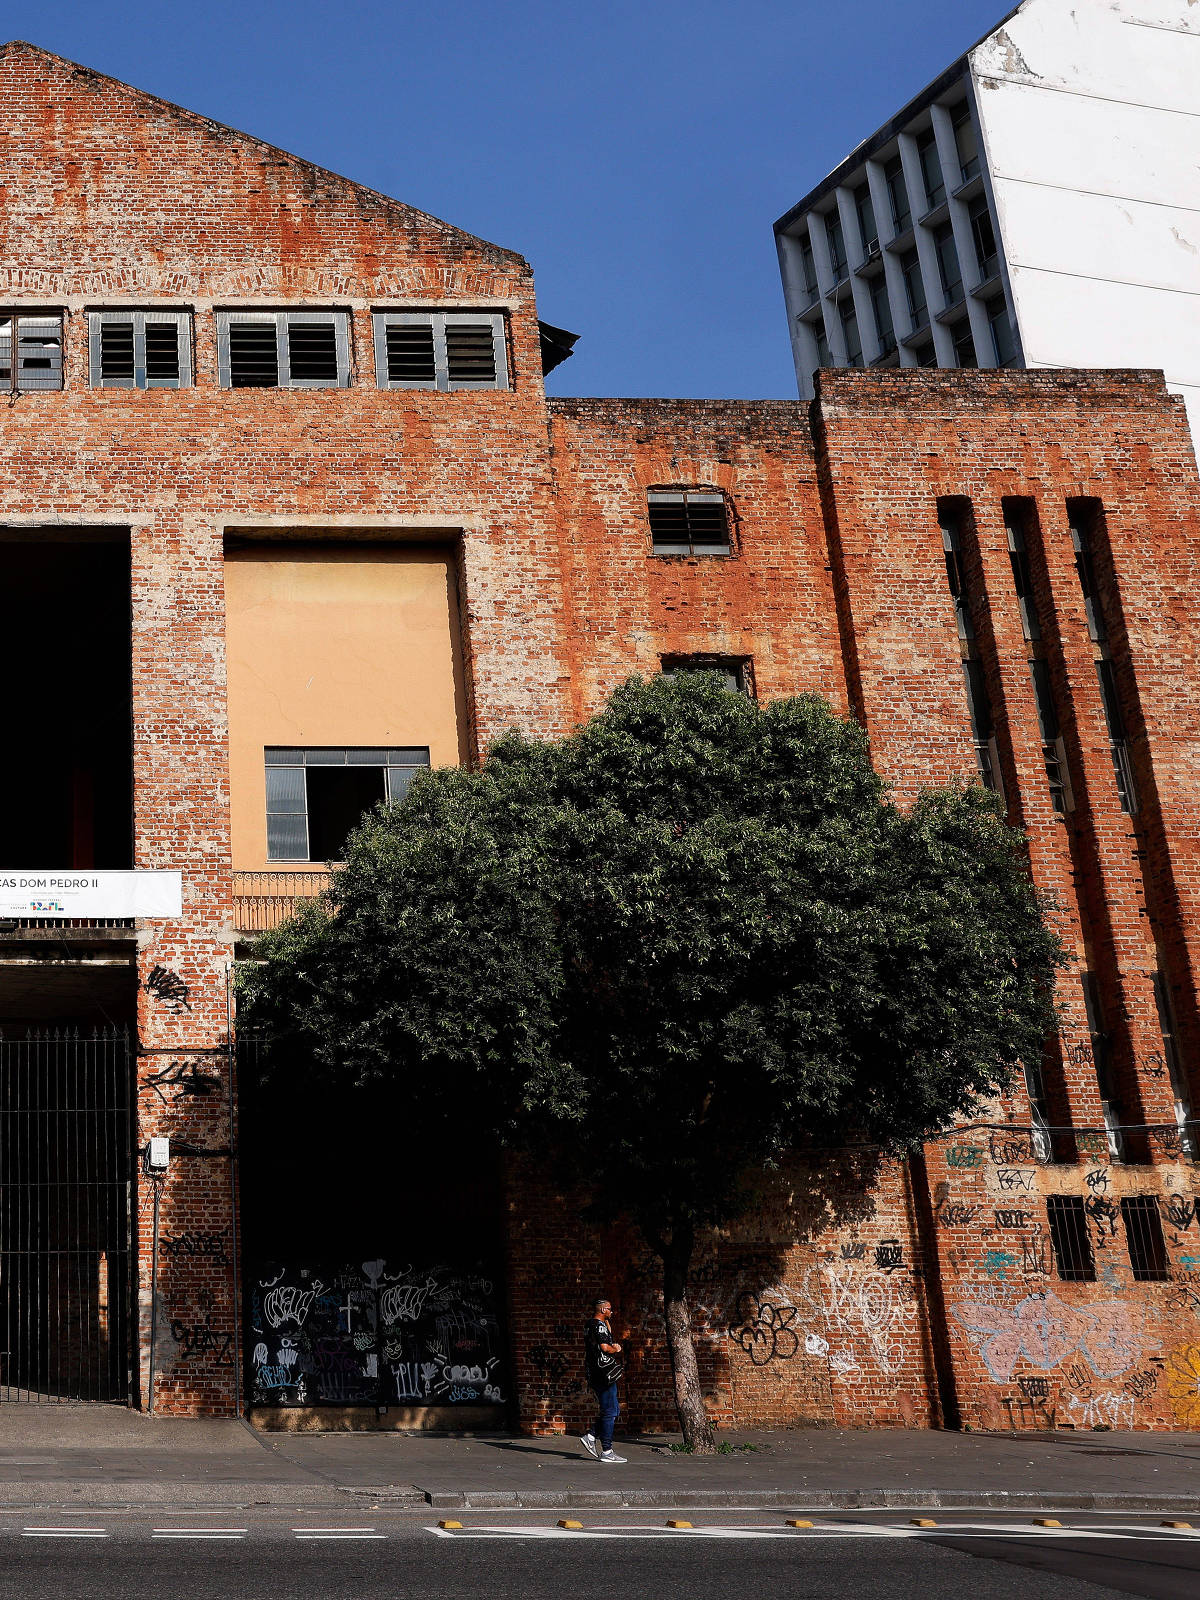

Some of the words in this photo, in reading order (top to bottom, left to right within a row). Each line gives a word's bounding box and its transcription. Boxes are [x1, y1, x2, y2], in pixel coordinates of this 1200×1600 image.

[19, 878, 47, 888] DOM
[50, 878, 89, 888] PEDRO
[91, 878, 99, 888] II
